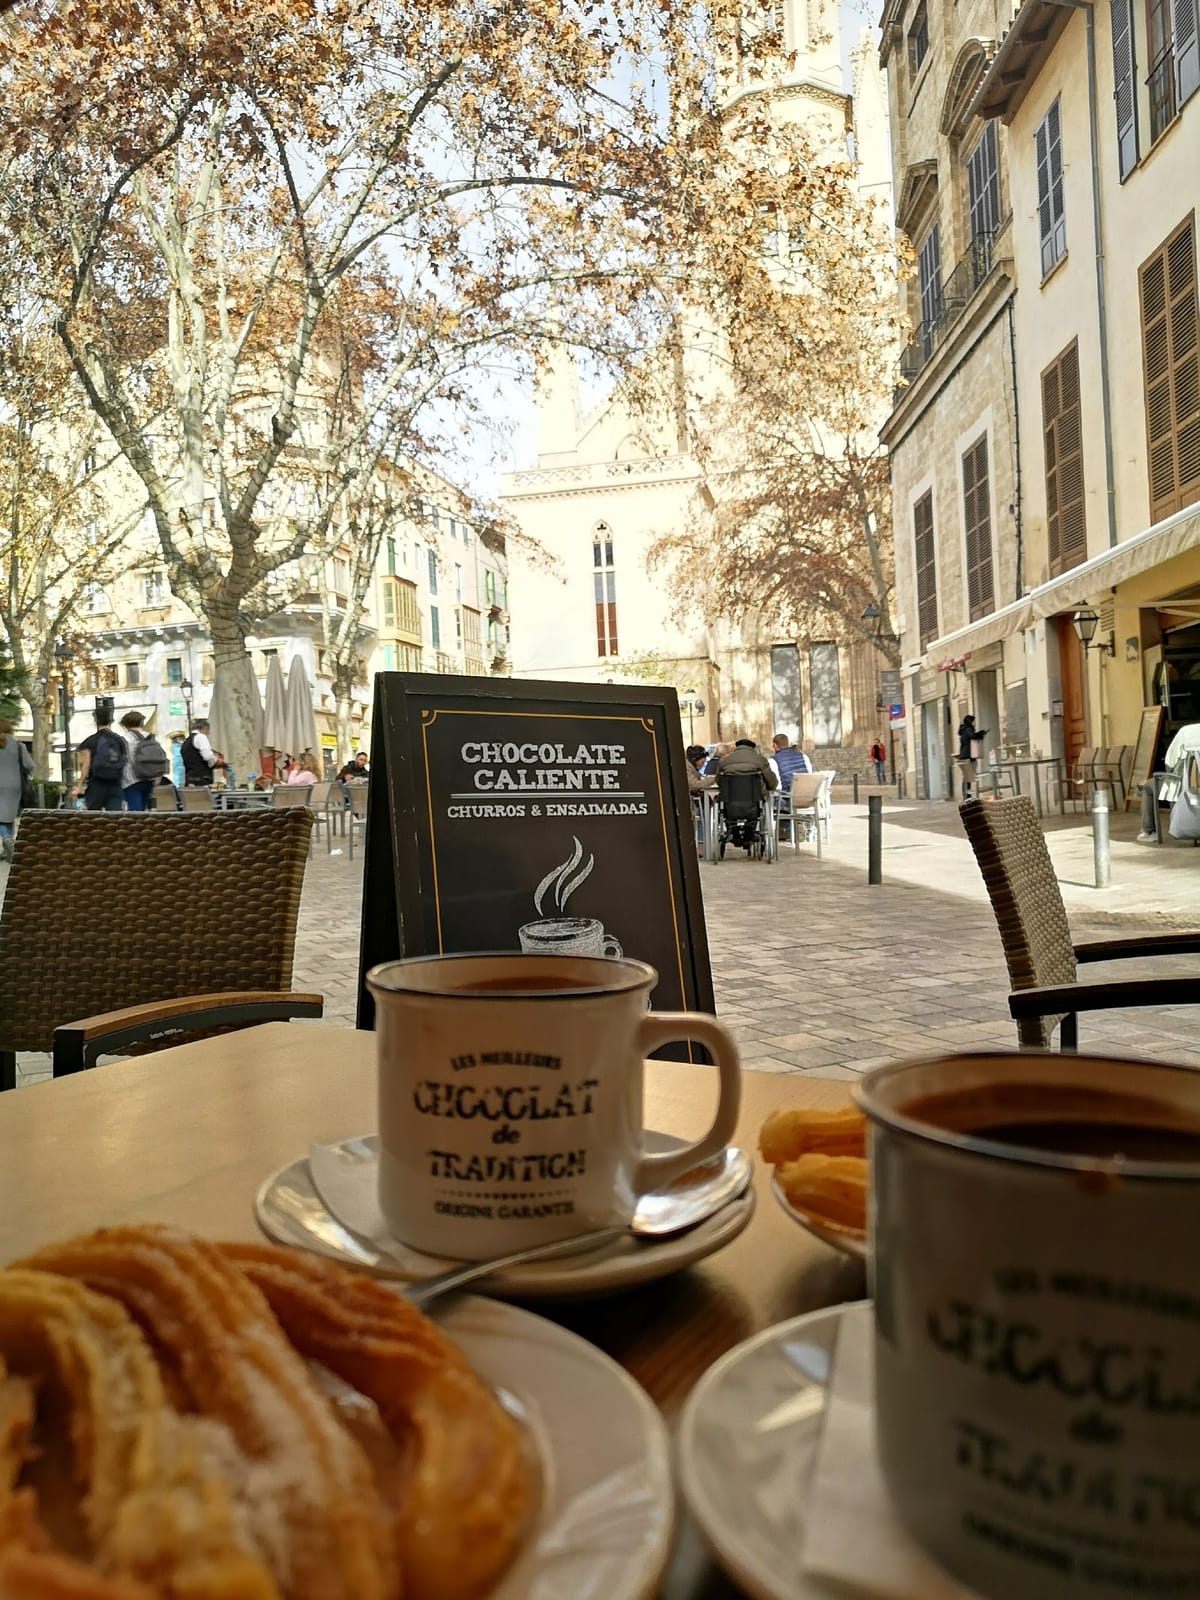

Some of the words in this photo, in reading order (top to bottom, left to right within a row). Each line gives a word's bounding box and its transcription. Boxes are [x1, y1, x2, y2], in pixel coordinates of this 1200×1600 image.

[461, 742, 626, 765] CHOCOLATE
[473, 769, 620, 790] CALIENTE
[447, 804, 526, 818] CHURROS
[531, 804, 542, 817] &
[545, 803, 648, 817] ENSAIMADAS
[413, 1079, 599, 1120] CHOCOLAT
[491, 1124, 521, 1144] de
[428, 1149, 586, 1182] TRADITION
